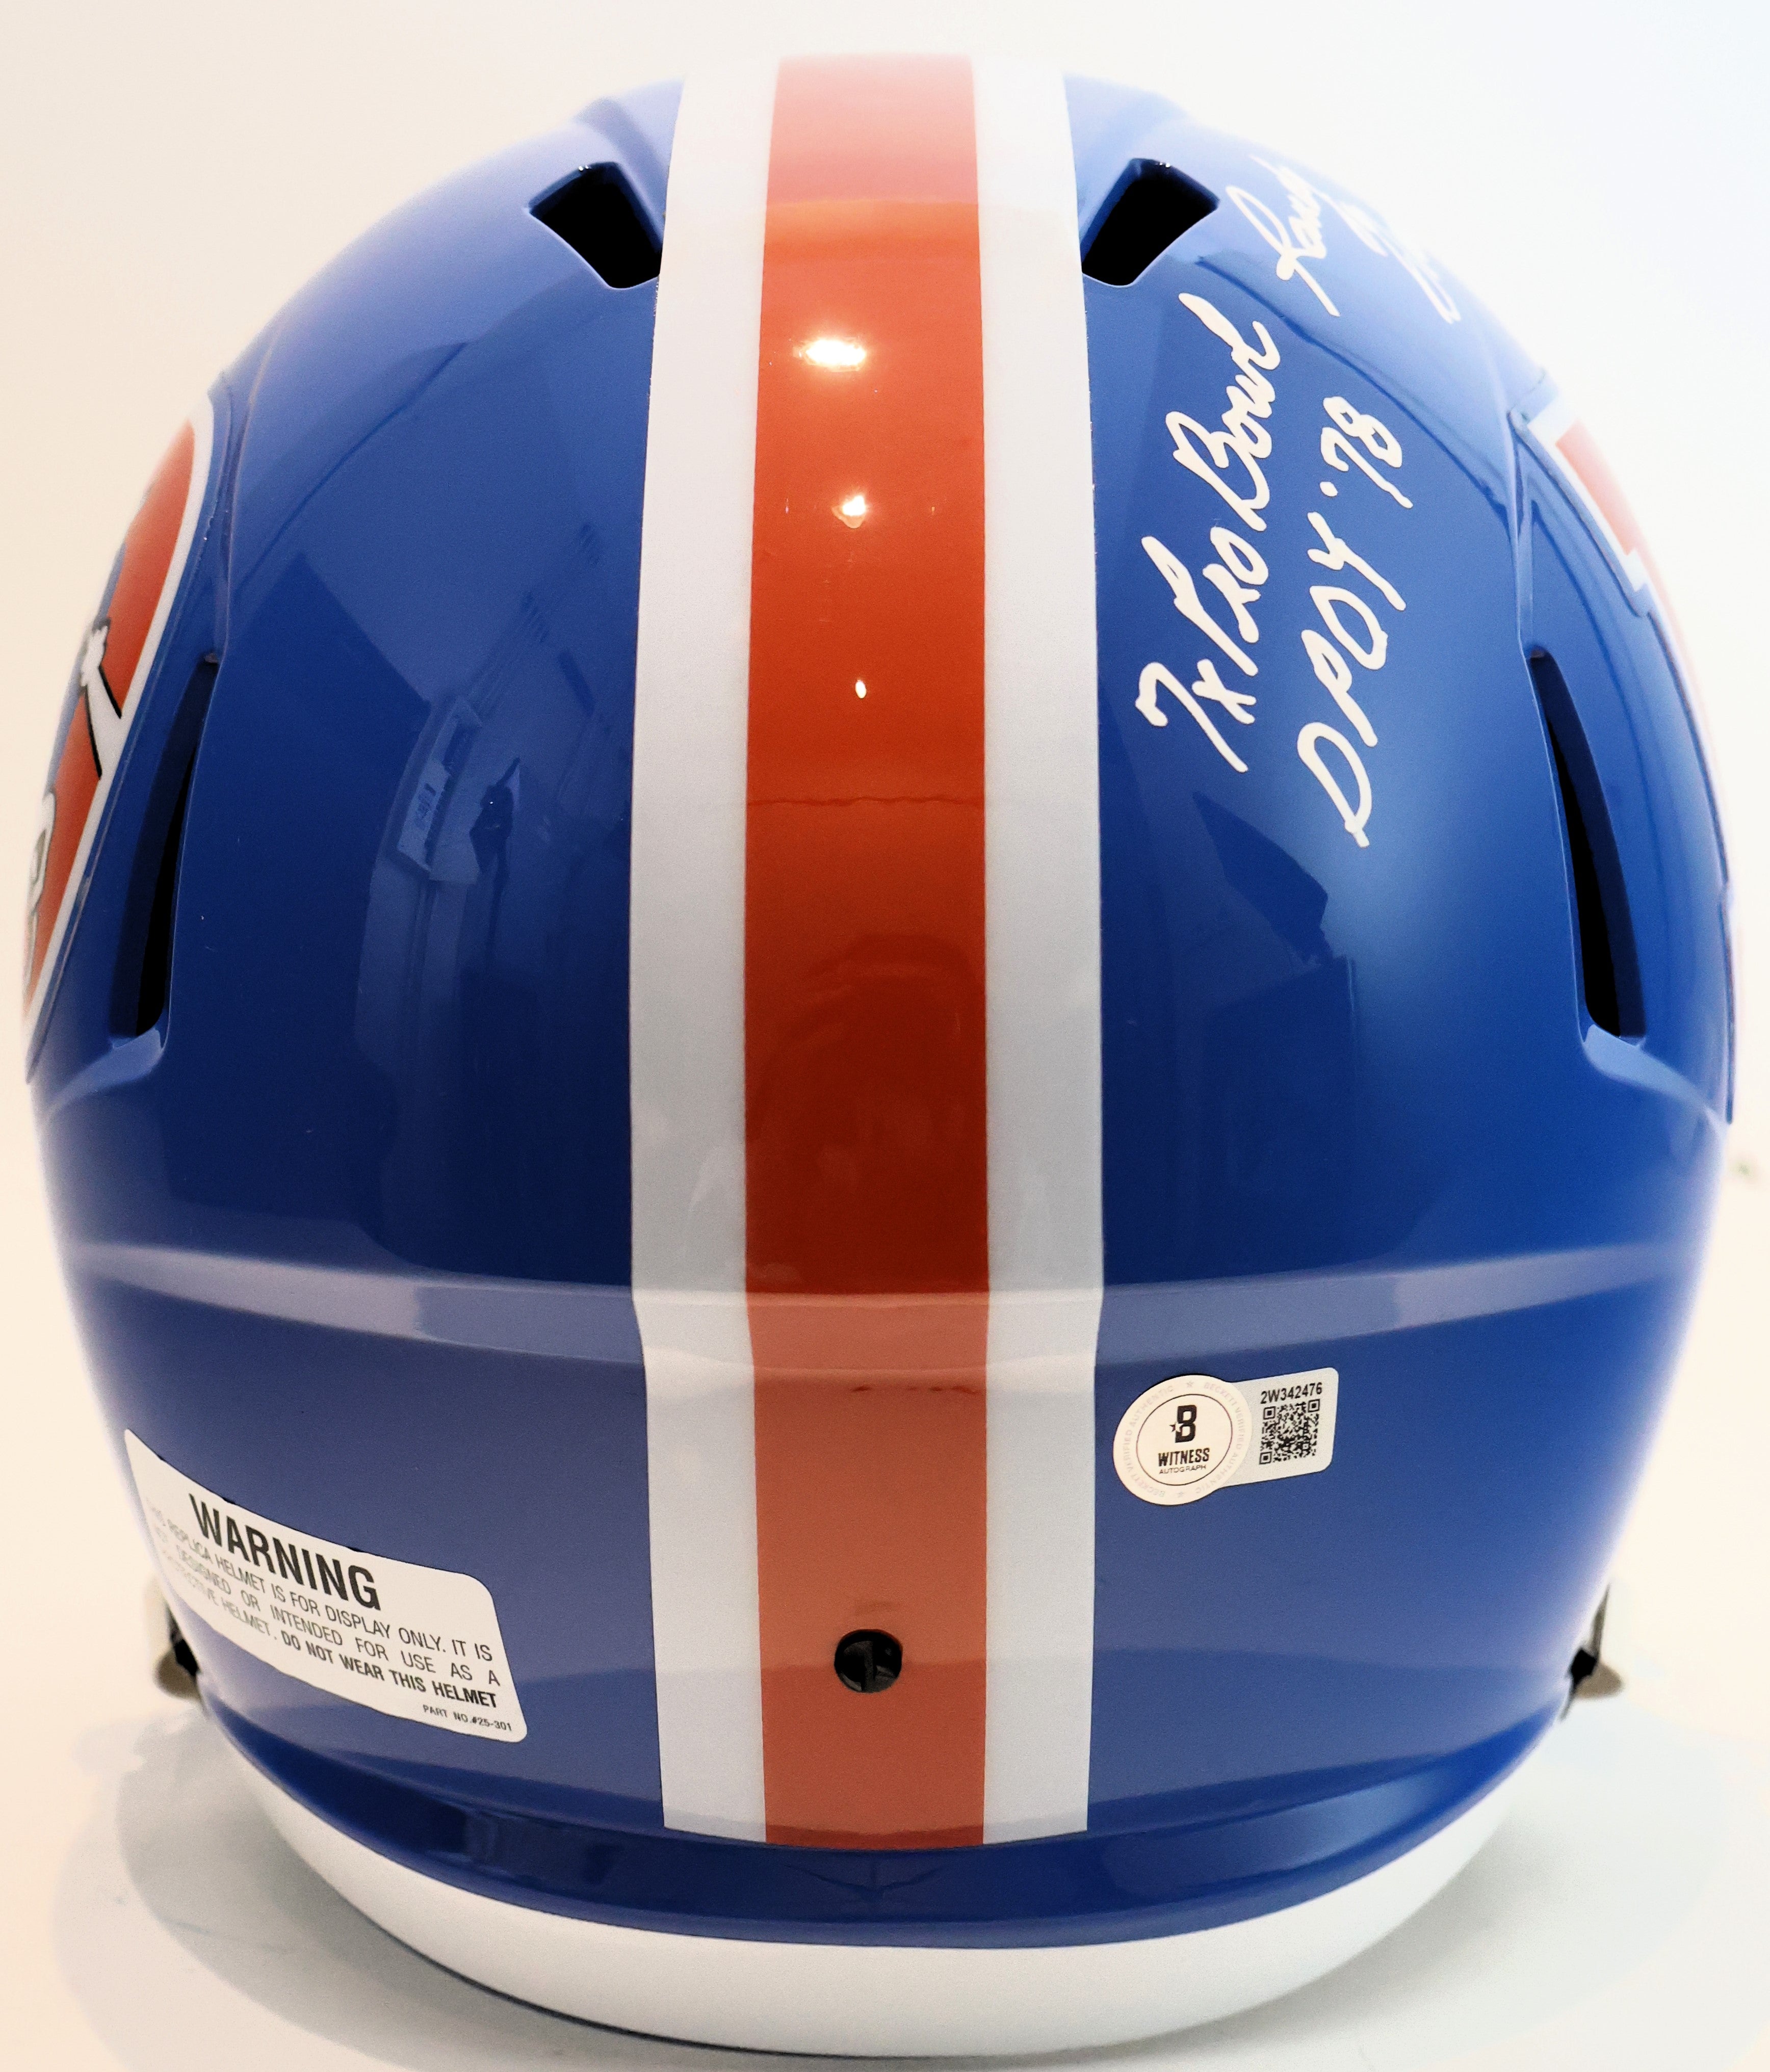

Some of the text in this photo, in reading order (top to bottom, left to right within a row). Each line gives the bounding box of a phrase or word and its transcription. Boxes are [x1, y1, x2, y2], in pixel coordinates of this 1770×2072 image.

[1135, 292, 1281, 773] 7x Pro Bowl
[1297, 512, 1407, 847] DPOY
[1261, 1382, 1323, 1404] 2W342476
[1158, 1447, 1211, 1467] WITNESS
[1159, 1464, 1207, 1475] AUTOGRAPH
[189, 1493, 381, 1611] WARNING
[215, 1553, 265, 1593] HELMET
[271, 1583, 286, 1603] IS
[290, 1591, 321, 1616] FOR
[325, 1605, 391, 1639] DISPLAY
[399, 1628, 447, 1653] ONLY.
[452, 1639, 466, 1657] IT
[474, 1643, 493, 1662] IS
[241, 1589, 261, 1612] OR
[270, 1604, 343, 1646] INTENDED
[355, 1637, 389, 1662] FOR
[401, 1650, 436, 1673] USE
[451, 1662, 473, 1681] AS
[488, 1669, 501, 1687] A
[281, 1630, 301, 1651] DO
[305, 1640, 333, 1664] NOT
[339, 1653, 385, 1681] WEAR
[388, 1669, 427, 1692] THIS
[432, 1680, 497, 1709] HELMET
[423, 1704, 448, 1718] PART
